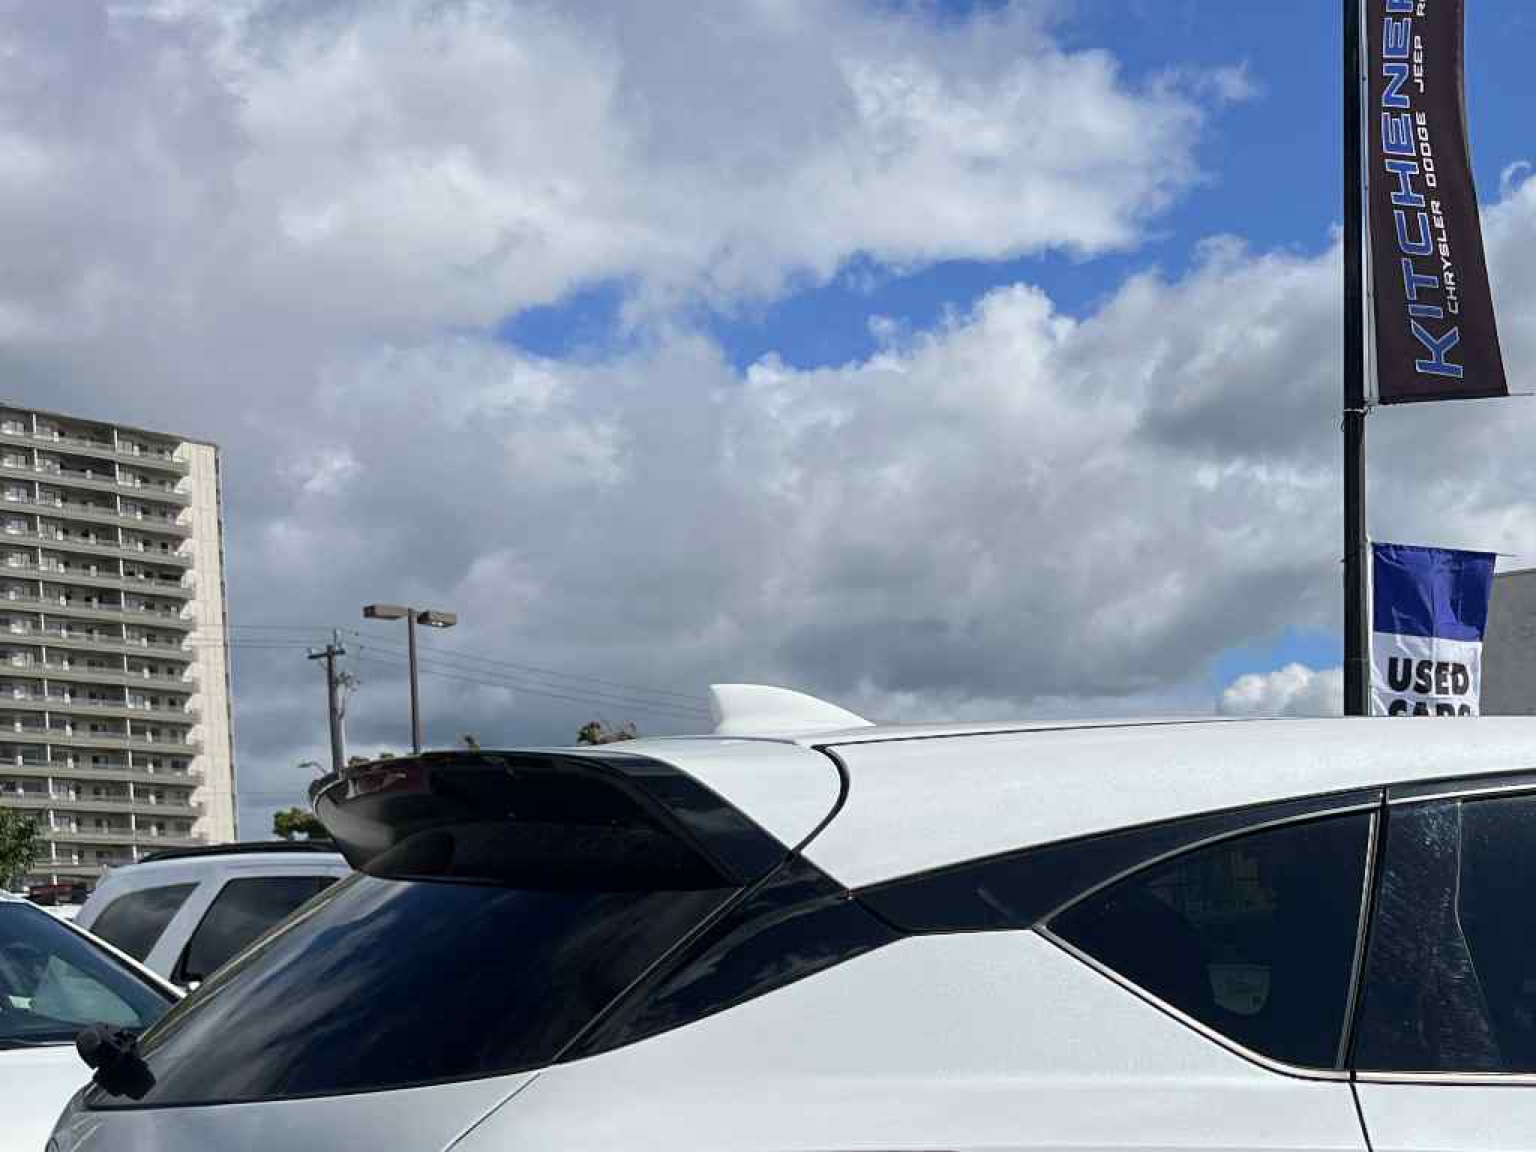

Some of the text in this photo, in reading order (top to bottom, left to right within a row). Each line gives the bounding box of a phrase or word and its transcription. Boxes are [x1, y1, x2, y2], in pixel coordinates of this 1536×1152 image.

[1413, 35, 1426, 94] JEEP
[1416, 111, 1436, 188] DODGE
[1430, 200, 1459, 315] CHRYSLER
[1388, 656, 1469, 695] USED
